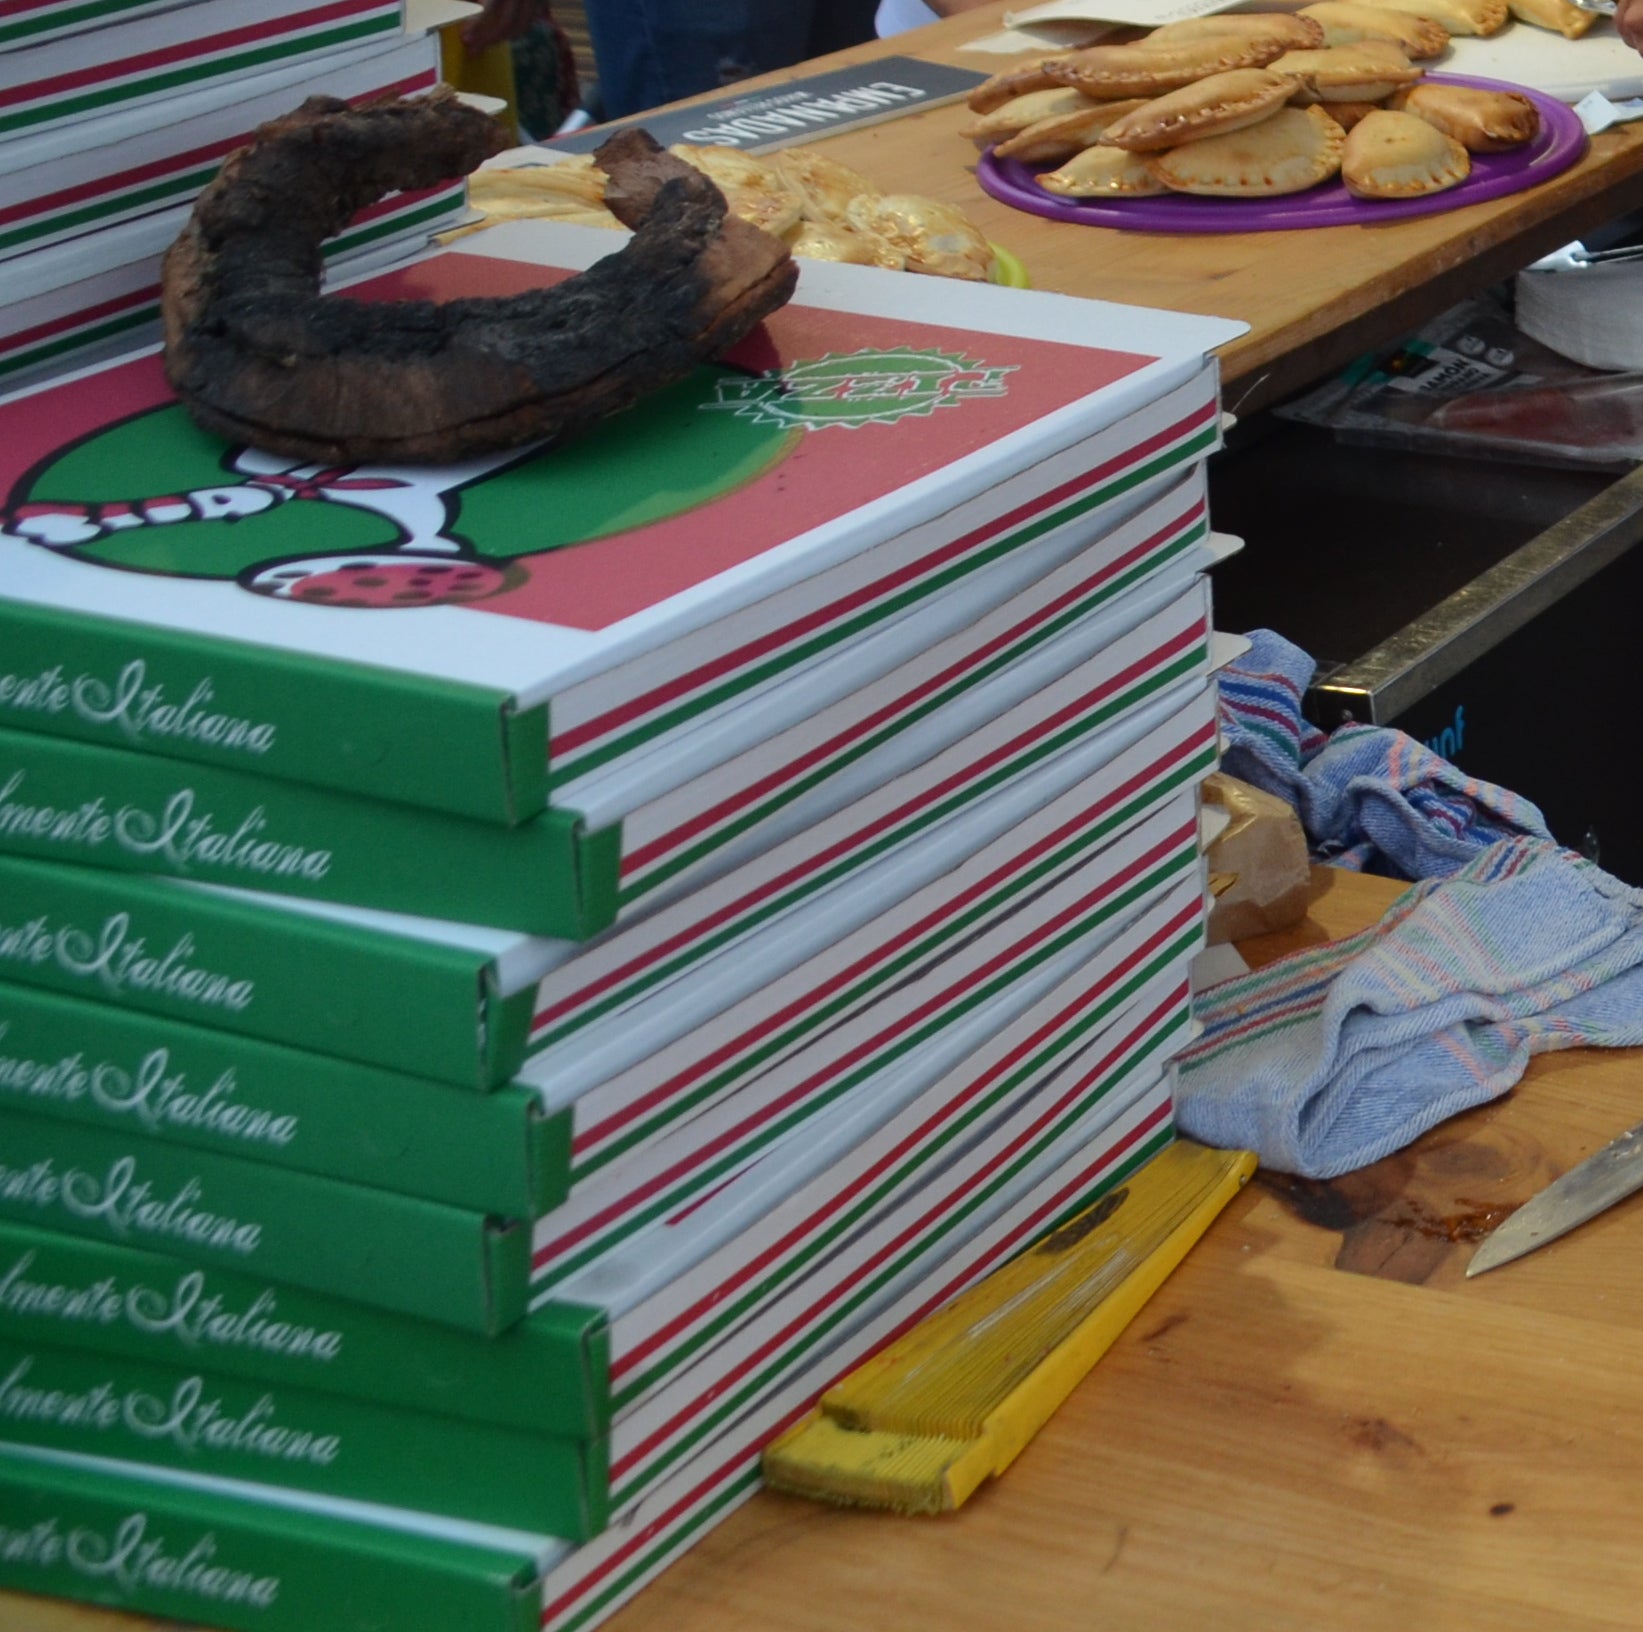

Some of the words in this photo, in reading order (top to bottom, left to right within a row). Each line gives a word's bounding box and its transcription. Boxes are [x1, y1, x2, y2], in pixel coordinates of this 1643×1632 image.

[682, 81, 927, 147] EMPANADAS
[698, 365, 1021, 410] PIZZA
[71, 659, 277, 755] Italiana
[113, 788, 332, 881] Italiana
[55, 911, 255, 1011] Italiana
[90, 1046, 298, 1145] Italiana
[61, 1154, 263, 1257] Italiana
[125, 1270, 343, 1361] Italiana
[123, 1374, 342, 1467] Italiana
[66, 1511, 281, 1609] Italiana
